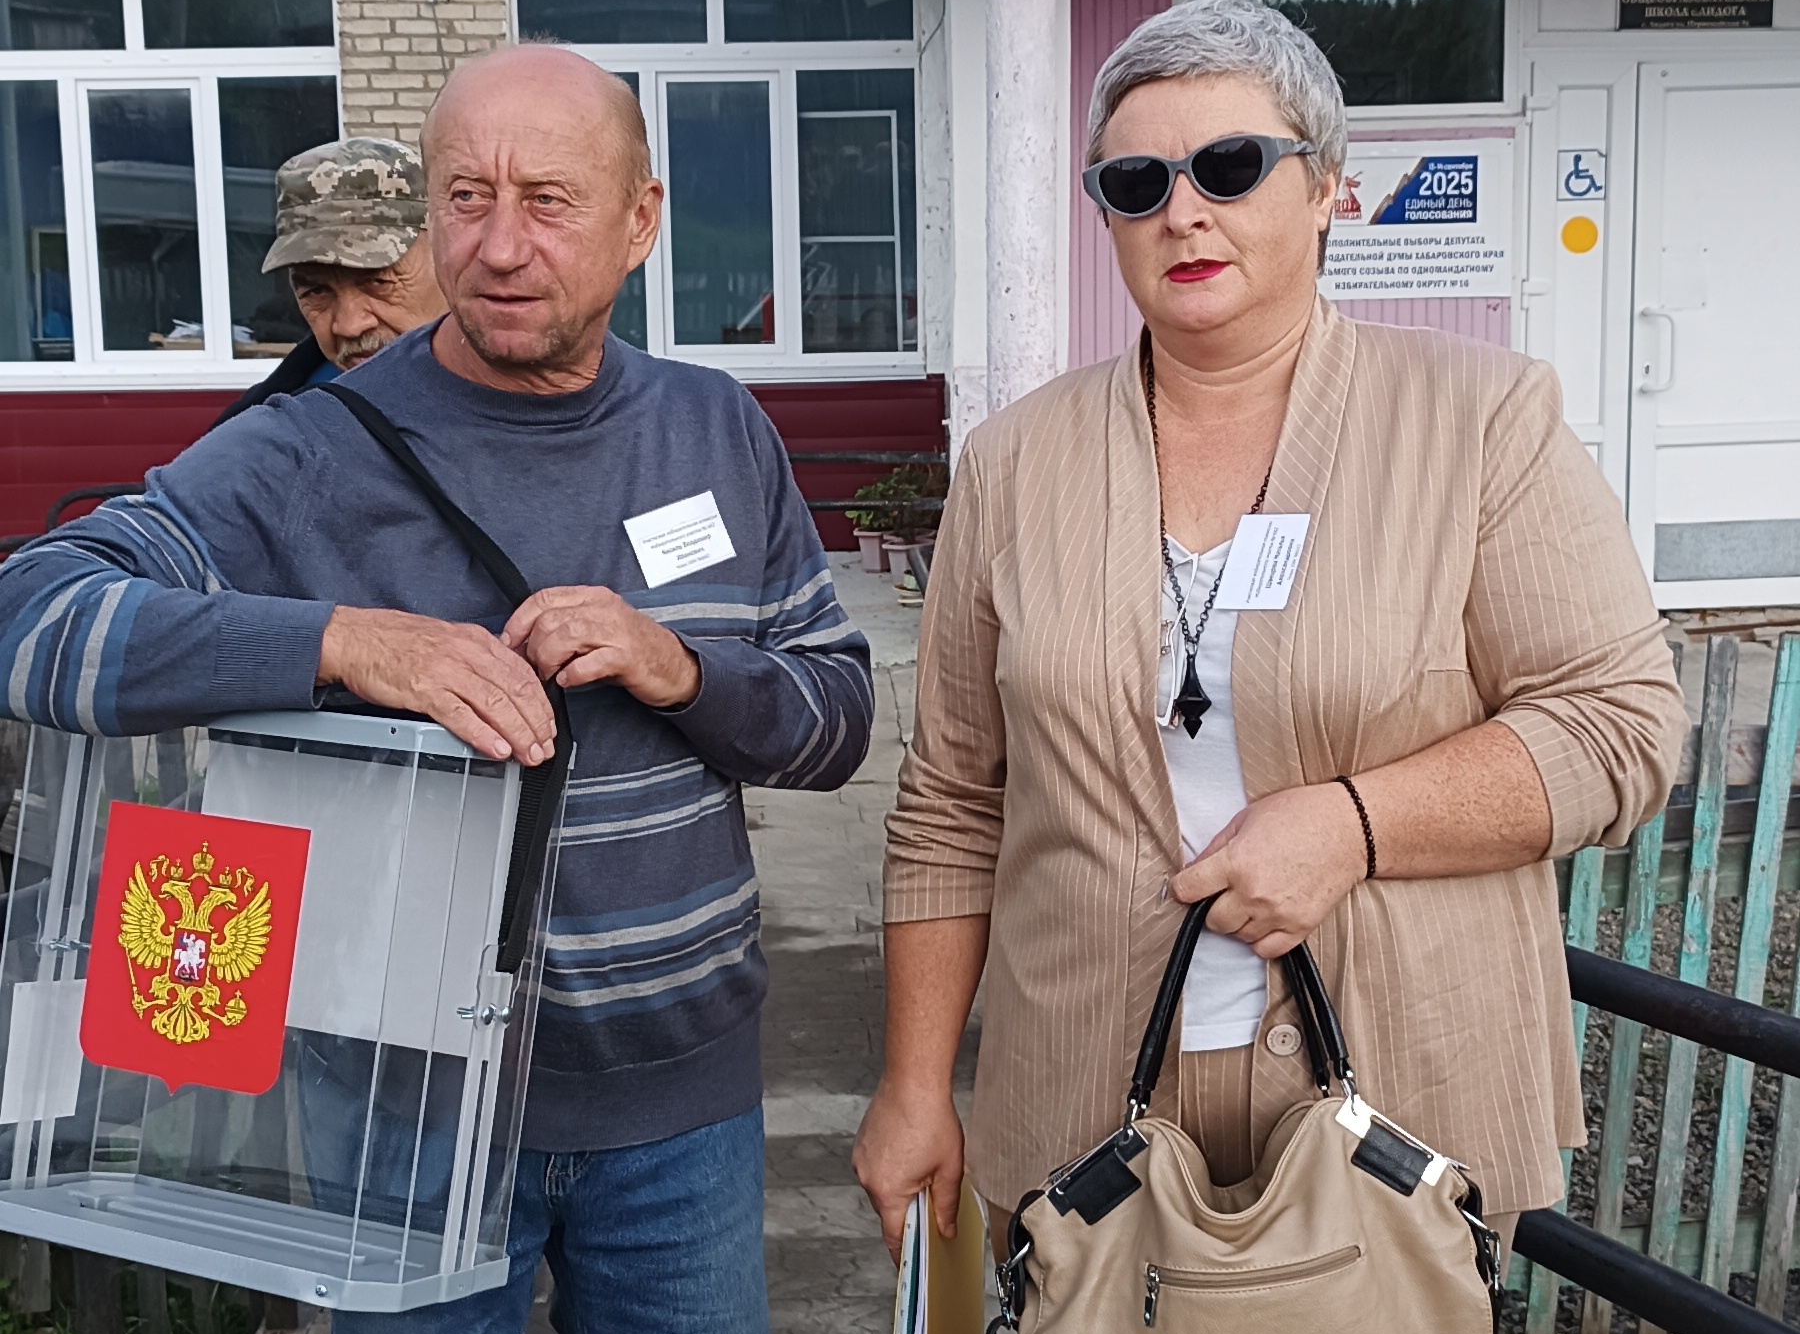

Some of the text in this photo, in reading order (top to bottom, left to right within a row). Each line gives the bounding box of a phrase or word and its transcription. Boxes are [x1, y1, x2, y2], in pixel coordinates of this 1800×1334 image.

[1644, 7, 1689, 18] ШКОЛА
[1419, 171, 1474, 196] 2025
[1405, 197, 1473, 210] ЕДИНЫЙ ДЕНЬ
[1327, 236, 1486, 248] ОПОЛНИТЕЛЬНЫЕ ВЫБОРЫ ДЕПУТАТА
[1324, 250, 1505, 263] ОДАТЕЛЬНОЙ ДУМЫ ХАБАРОВСКОГО КРАЯ
[1359, 266, 1396, 276] СОЗЫВА
[1397, 266, 1409, 275] ПО
[1411, 265, 1494, 275] ОДНОМАНДАТНОМУ
[1335, 280, 1415, 290] ИЗБИРАТЕЛЬНОМУ
[1416, 280, 1447, 289] ОКРУГУ
